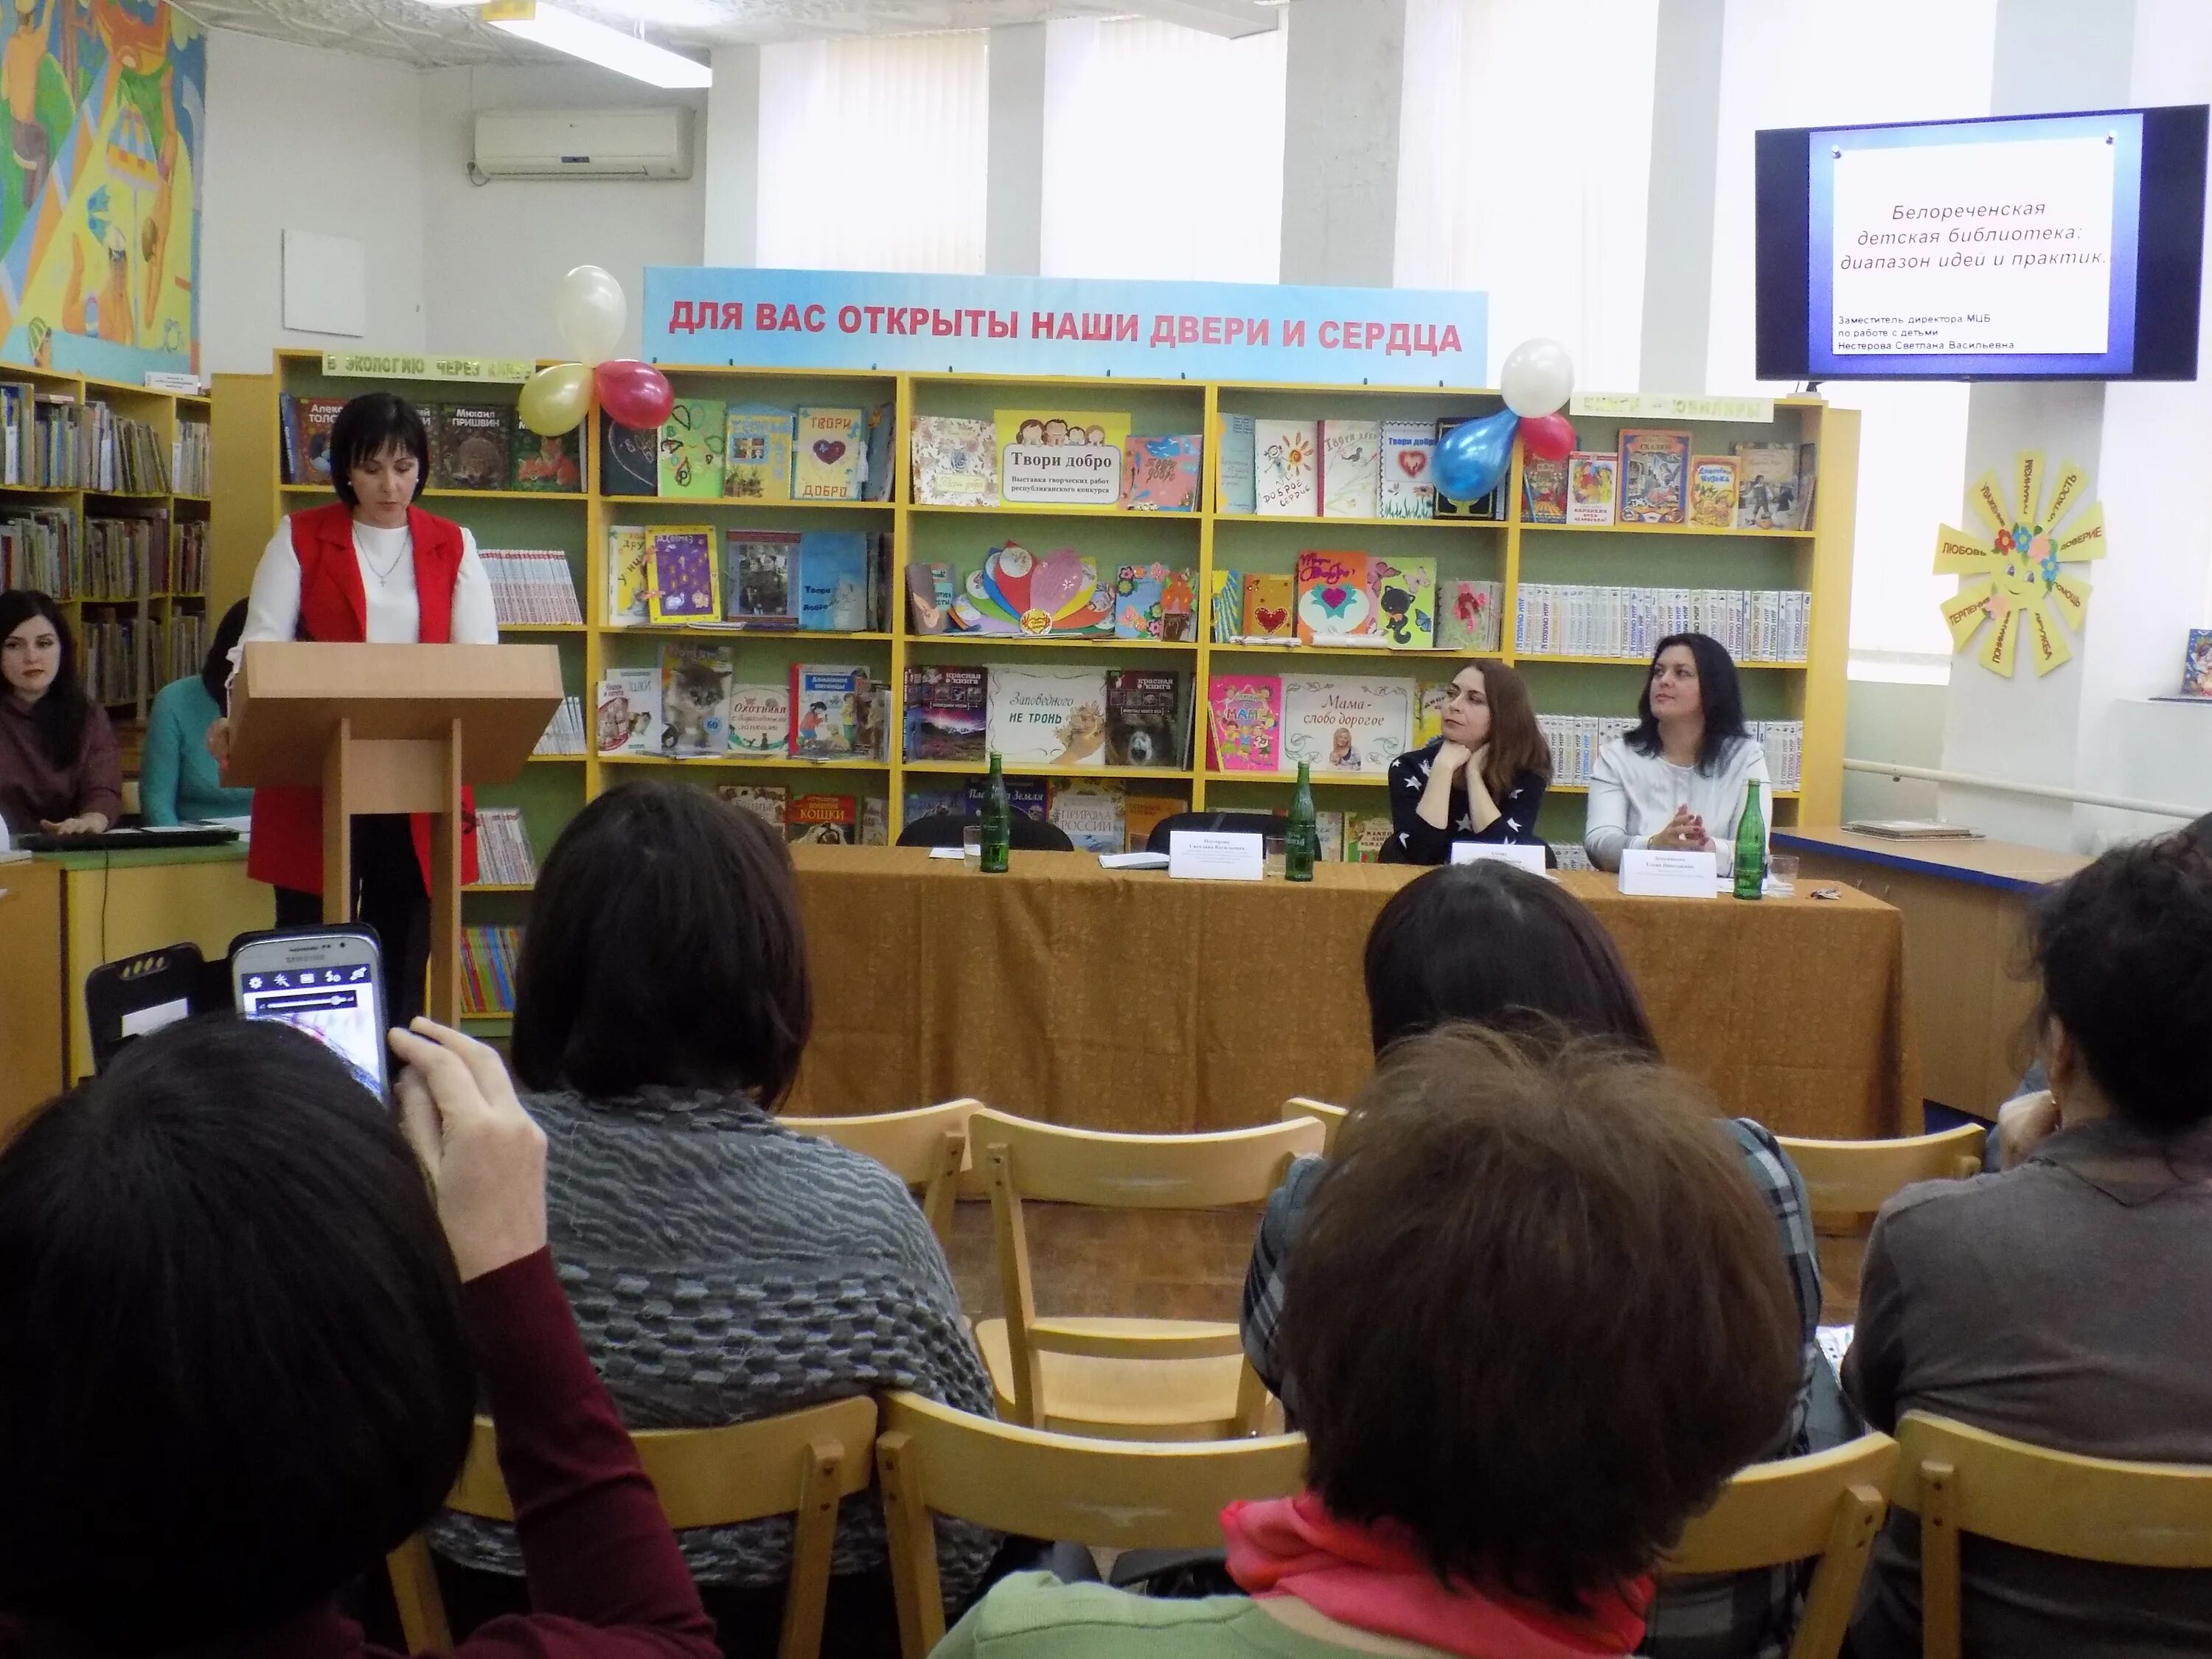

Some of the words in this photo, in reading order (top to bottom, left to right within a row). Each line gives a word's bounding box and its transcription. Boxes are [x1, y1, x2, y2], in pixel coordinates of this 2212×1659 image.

[1892, 204, 2045, 221] Белореченская
[1857, 231, 1940, 245] детская
[1948, 227, 2083, 243] библиотека:
[1840, 255, 1930, 270] диапазон
[1938, 251, 1986, 267] идей
[1994, 255, 2004, 266] и
[2011, 252, 2107, 269] практик.
[1838, 316, 1904, 324] Заместитель
[1907, 316, 1962, 326] директора
[1966, 314, 1991, 323] МЦБ
[669, 301, 742, 333] ДЛЯ
[756, 303, 824, 332] ВАС
[838, 306, 1018, 338] ОТКРЫТЫ
[1032, 312, 1138, 341] НАШИ
[1150, 316, 1268, 347] ДВЕРИ
[1283, 321, 1304, 345] И
[1318, 322, 1462, 355] СЕРДЦА
[1854, 328, 1888, 338] работе
[1838, 341, 1891, 351] Нестерова
[1895, 341, 1944, 349] Светлана
[1949, 341, 2014, 349] Васильевна
[327, 355, 337, 371] В
[345, 356, 425, 374] ЭКОЛОГИЮ
[437, 359, 480, 377] ЧЕРЕЗ
[311, 404, 344, 413] Алекс
[456, 408, 496, 418] Михаил
[309, 414, 339, 423] ТОЛС
[451, 417, 500, 428] ПРИШВИН
[810, 417, 852, 430] ТВОРИ
[1388, 437, 1412, 446] Твори
[1413, 438, 1438, 446] добр
[1011, 451, 1061, 470] Твори
[1065, 453, 1112, 470] добро
[803, 484, 847, 498] ДОБРО
[1077, 487, 1110, 495] конкурса
[2060, 526, 2102, 552] ДОВЕРИЕ
[1942, 542, 1987, 557] ЛЮБОВЬ
[1009, 691, 1074, 707] Заповедного
[734, 703, 787, 714] Охотники
[1009, 712, 1023, 723] НЕ
[1029, 713, 1062, 725] ТРОНЬ
[1303, 712, 1336, 725] слово
[1338, 712, 1385, 726] дорогое
[1014, 790, 1044, 801] Земля
[800, 808, 844, 821] КОШКИ
[1062, 810, 1112, 821] ПРИРОДА
[1061, 820, 1112, 832] РОССИИ
